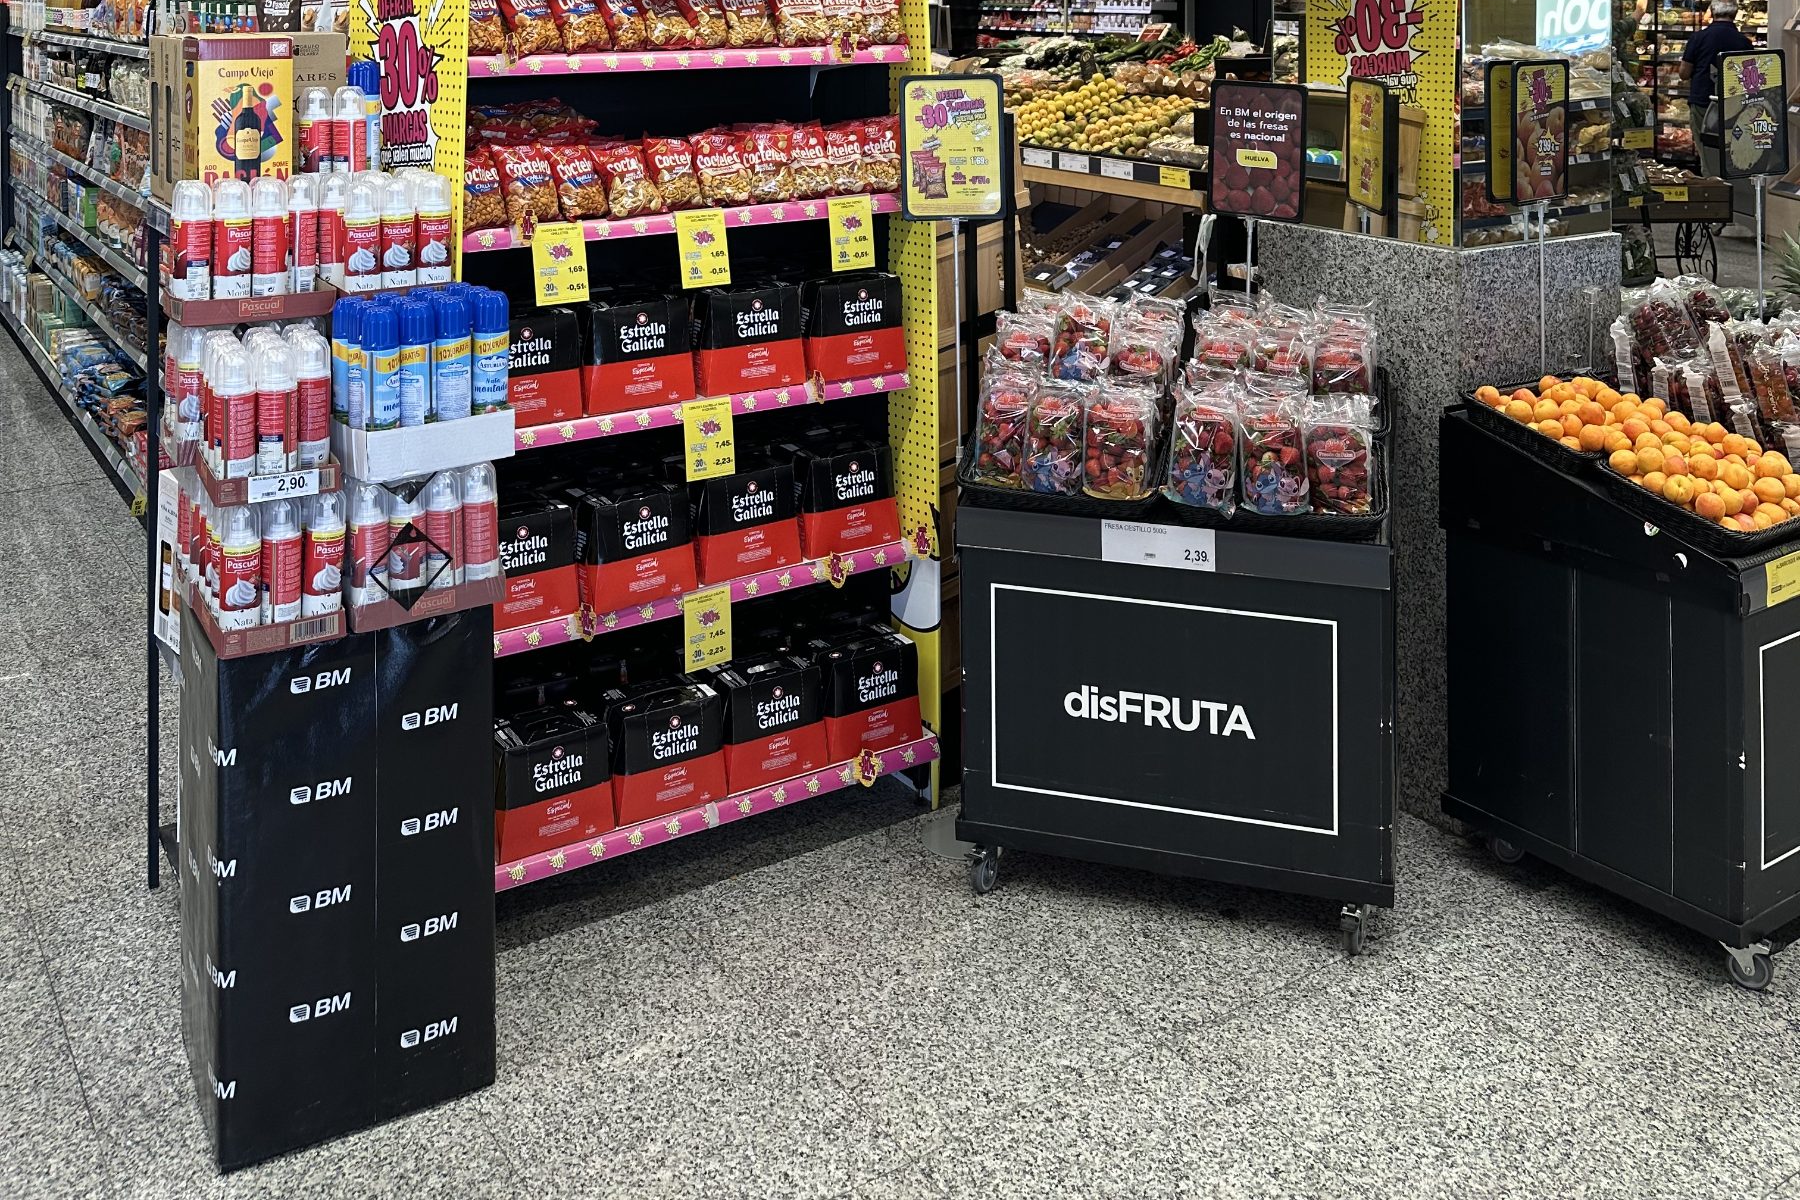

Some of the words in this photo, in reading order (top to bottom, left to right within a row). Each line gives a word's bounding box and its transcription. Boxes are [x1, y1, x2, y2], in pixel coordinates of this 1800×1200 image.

[218, 67, 249, 81] Campo
[250, 66, 274, 80] Viejo
[379, 19, 439, 111] 30%
[1220, 107, 1232, 116] En
[1234, 108, 1250, 117] BM
[1252, 110, 1261, 118] el
[1264, 111, 1297, 121] origen
[382, 109, 428, 146] MARCAS
[1227, 119, 1240, 128] de
[1243, 120, 1256, 129] las
[1259, 121, 1289, 131] fresas
[1244, 132, 1285, 143] nacional
[381, 147, 392, 167] que
[697, 151, 740, 168] Cocteleo
[1244, 155, 1270, 163] HUELVA
[506, 157, 551, 178] Cocteleo
[348, 229, 377, 239] Pascual
[383, 226, 412, 235] Pascual
[421, 222, 449, 231] Pascual
[241, 299, 280, 312] Pascual
[843, 298, 883, 314] Estrella
[736, 308, 780, 326] Estrella
[844, 311, 881, 326] Galicia
[619, 322, 667, 340] Estrella
[737, 322, 778, 338] Galicia
[508, 337, 552, 355] strella
[621, 335, 665, 353] Galicia
[835, 470, 875, 488] Estrella
[732, 489, 775, 510] Estrella
[837, 483, 874, 501] Galicia
[733, 504, 773, 522] Galicia
[622, 515, 669, 537] Estrella
[1104, 522, 1123, 530] FRESA
[1124, 524, 1151, 533] CESTILLO
[1152, 526, 1167, 535] 500G
[499, 534, 549, 556] Estrella
[624, 529, 668, 550] Galicia
[227, 557, 259, 569] Pascual
[500, 549, 547, 570] Galicia
[314, 667, 352, 691] BM
[858, 670, 898, 690] Estrella
[859, 684, 896, 703] Galicia
[424, 702, 459, 726] BM
[756, 694, 801, 717] Estrella
[1063, 684, 1256, 741] disFRUTA
[758, 708, 799, 729] Galicia
[652, 723, 700, 748] Estrella
[653, 738, 698, 760] Galicia
[533, 754, 584, 779] Estrella
[315, 776, 352, 801] BM
[534, 769, 582, 792] Galicia
[424, 807, 459, 832] BM
[314, 884, 352, 909] BM
[424, 911, 458, 937] BM
[314, 991, 352, 1018] BM
[424, 1016, 458, 1042] BM
